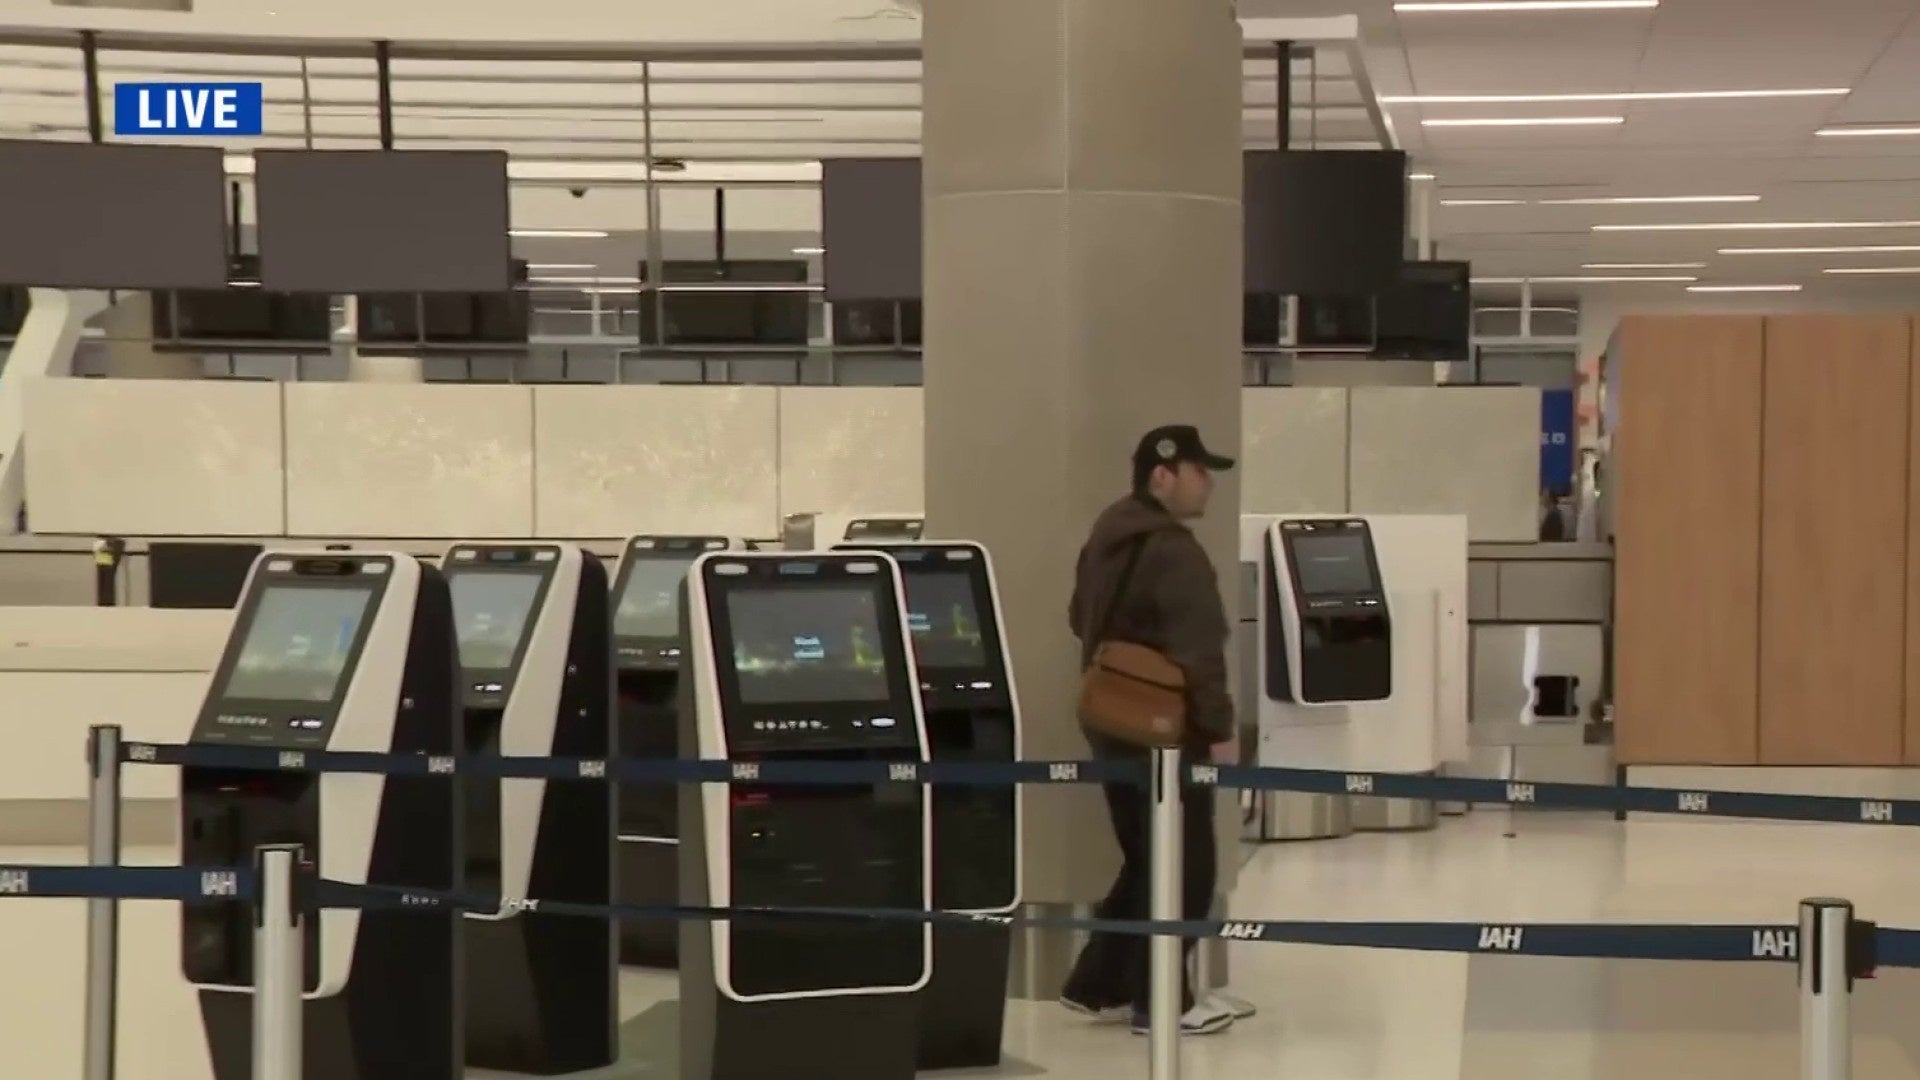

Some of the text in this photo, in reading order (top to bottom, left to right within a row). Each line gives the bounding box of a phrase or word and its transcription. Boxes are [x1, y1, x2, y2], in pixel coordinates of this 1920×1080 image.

[1860, 801, 1891, 820] IAH
[0, 870, 28, 892] AH
[201, 871, 236, 895] IAH
[1218, 922, 1264, 938] IAH
[1478, 926, 1520, 950] IAH
[1752, 930, 1795, 956] IAH
